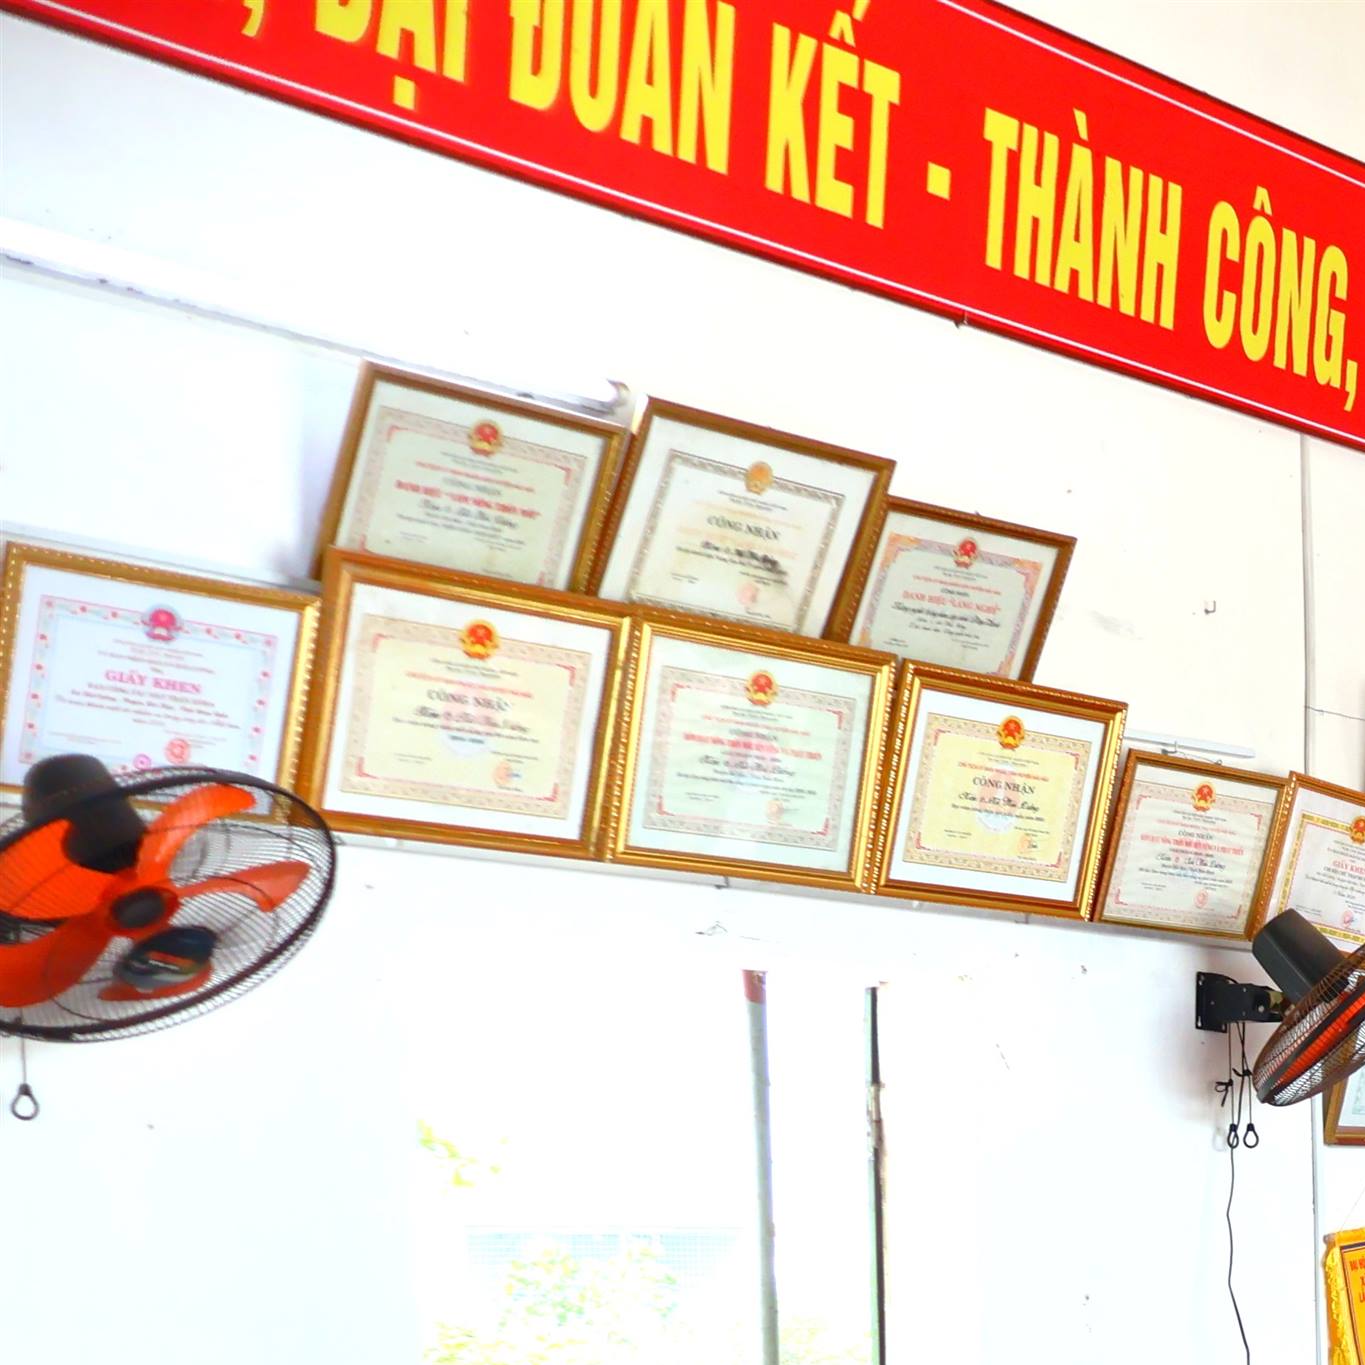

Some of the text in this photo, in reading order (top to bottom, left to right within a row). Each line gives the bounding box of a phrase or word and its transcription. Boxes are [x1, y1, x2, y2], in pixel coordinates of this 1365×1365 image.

[766, 0, 900, 228] KẾT
[927, 163, 950, 199] -
[984, 107, 1182, 330] THÀNH
[1203, 185, 1357, 411] CÔNG,
[972, 775, 1035, 796] CÔNG NHẬN
